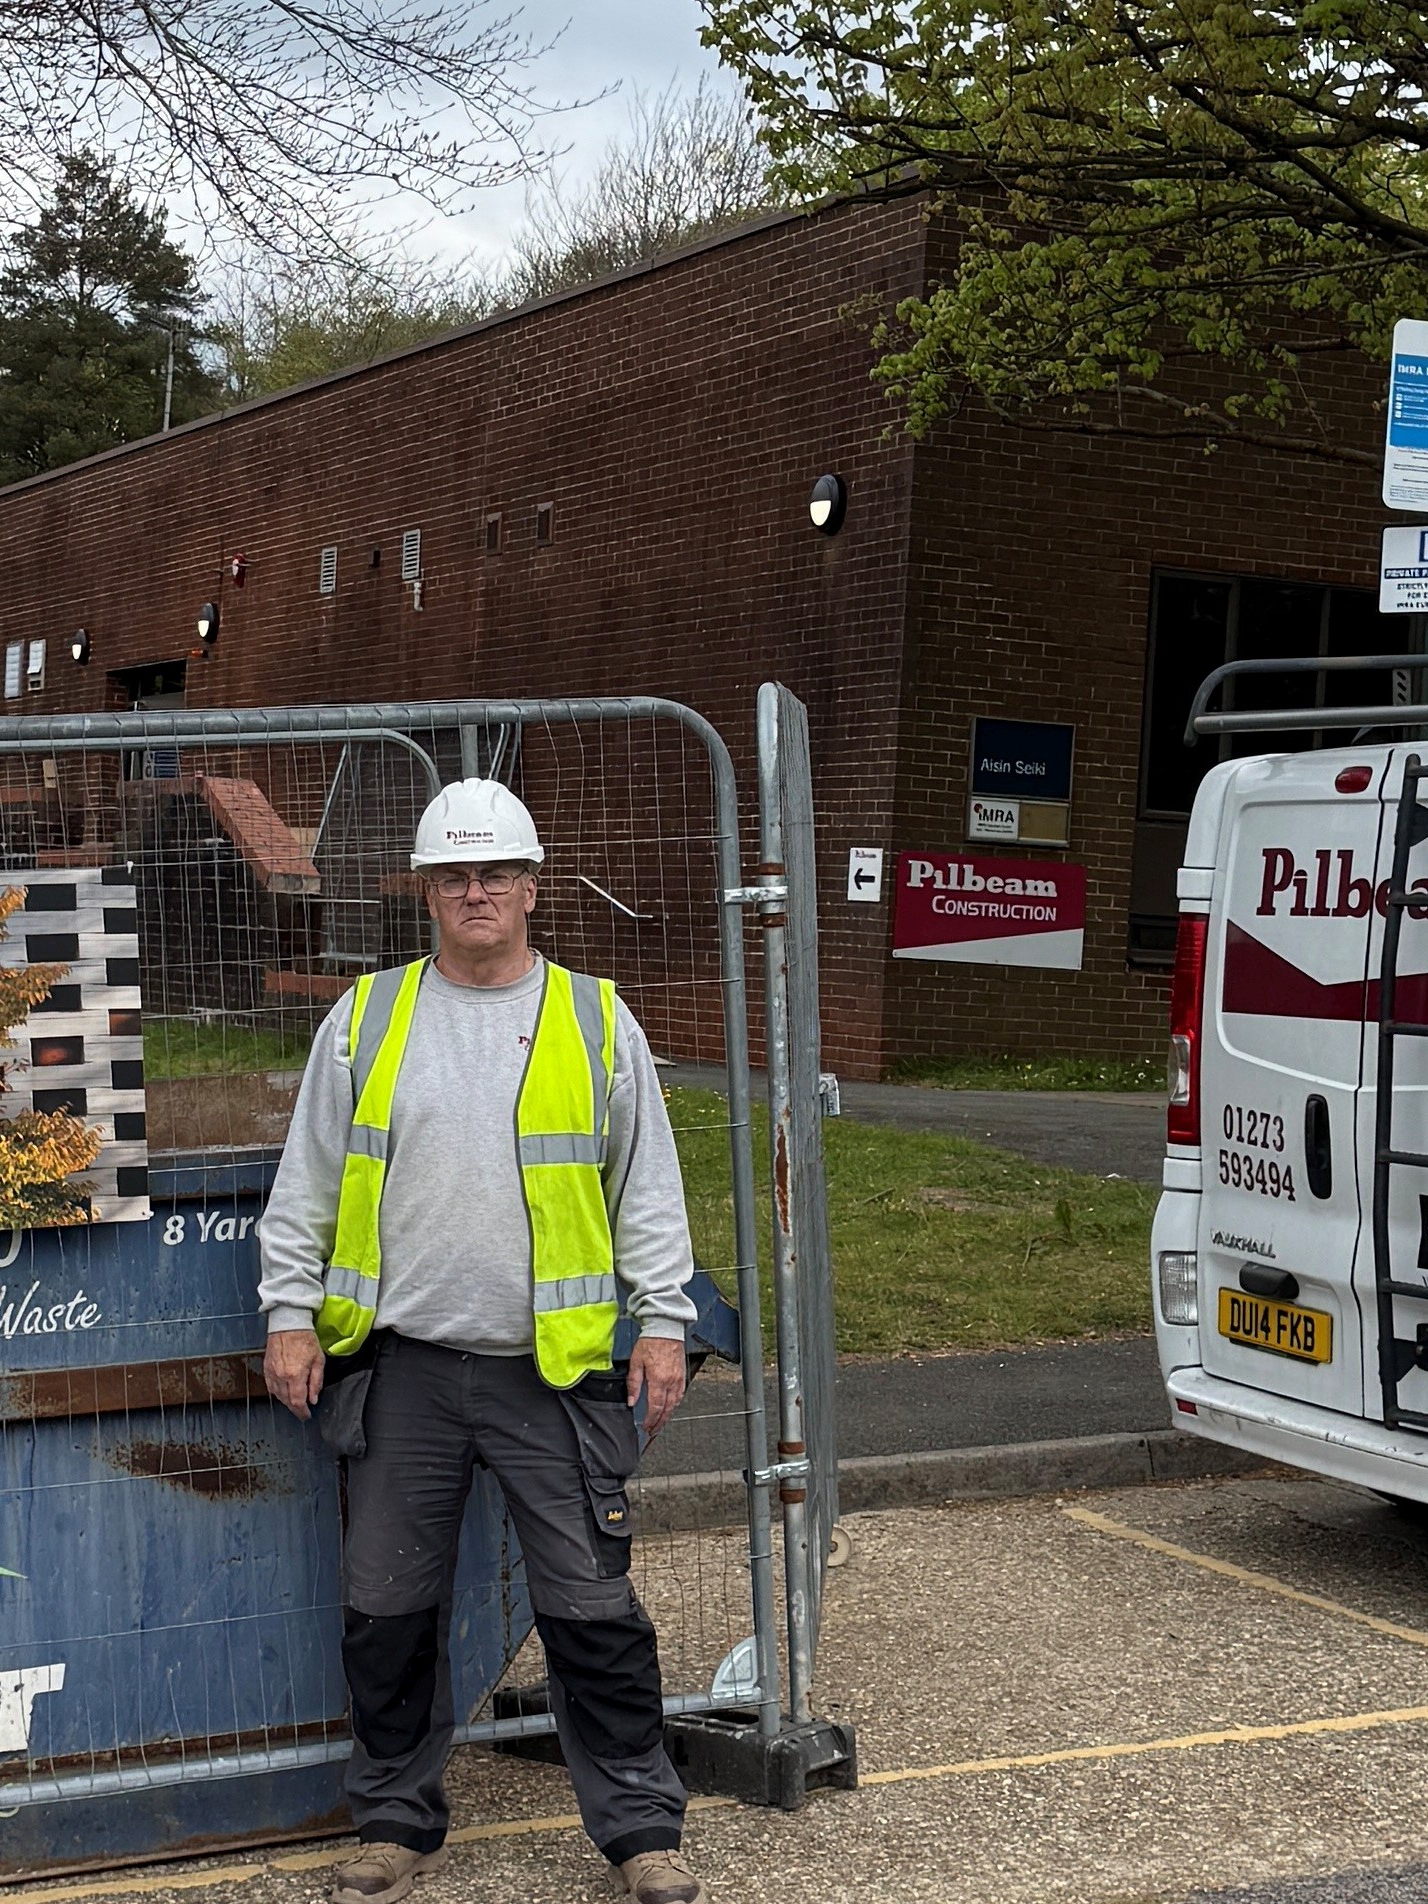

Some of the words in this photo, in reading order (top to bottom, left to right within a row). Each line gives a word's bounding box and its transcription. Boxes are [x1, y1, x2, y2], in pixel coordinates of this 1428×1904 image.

[1397, 363, 1423, 375] IMRA
[980, 757, 1010, 774] Aisin
[1015, 760, 1046, 776] Seiki
[906, 859, 1058, 898] Pilbeam
[932, 895, 1057, 922] CONSTRUCTION
[1223, 1104, 1285, 1153] 01273
[1219, 1149, 1296, 1202] 593494
[163, 1214, 185, 1246] 8
[1210, 1228, 1276, 1259] VAUXHALL
[1229, 1296, 1271, 1342] DU14
[1276, 1308, 1316, 1353] FKB
